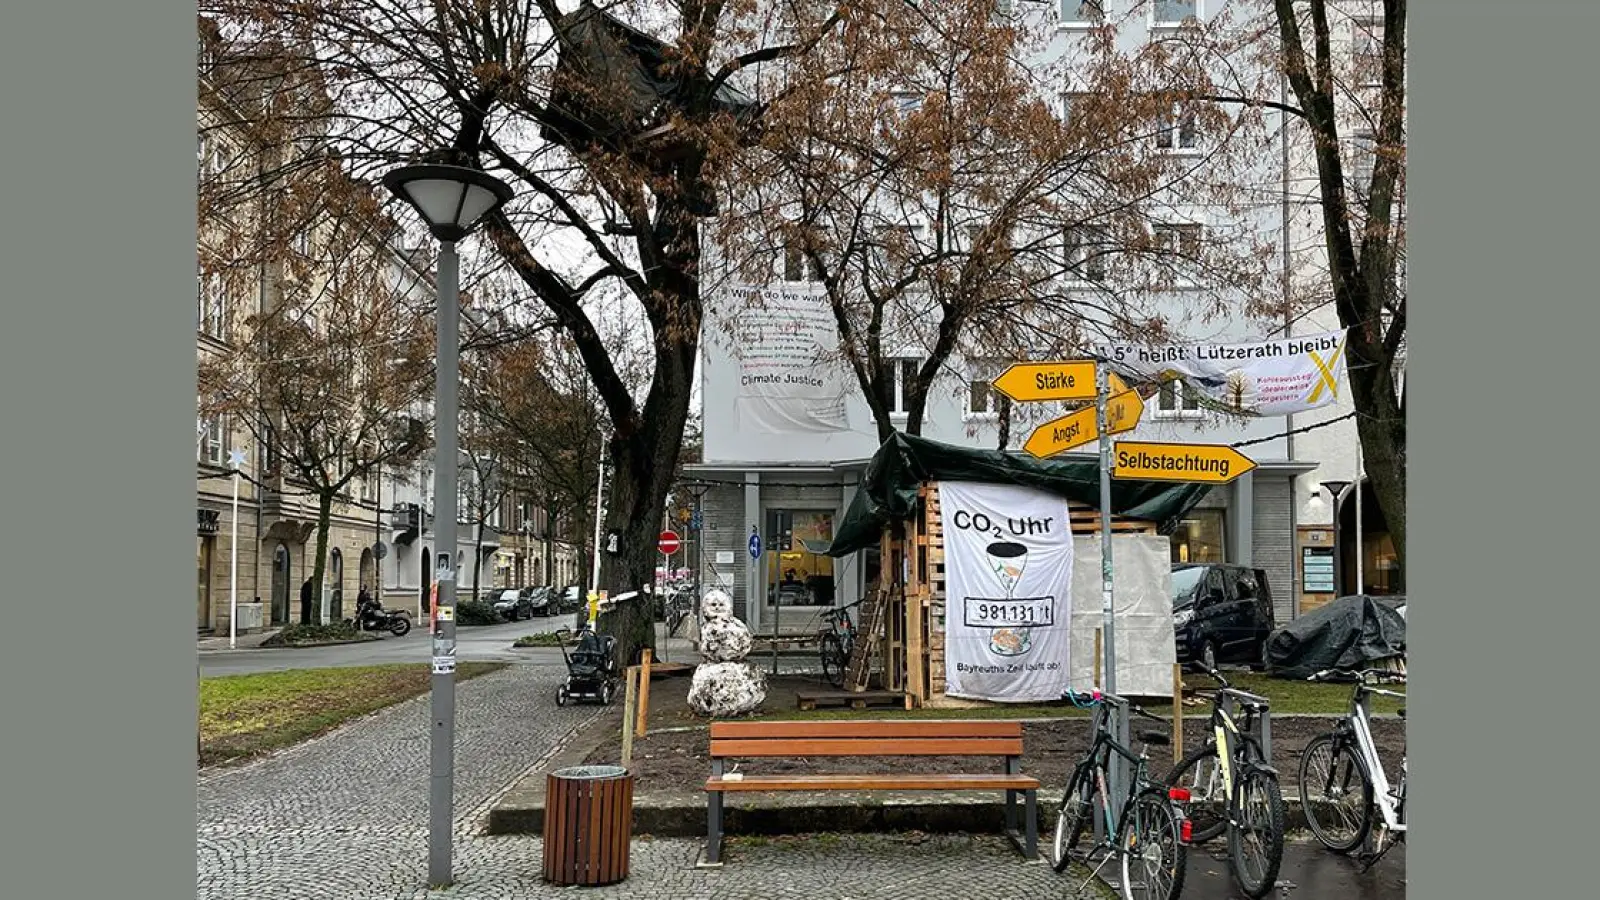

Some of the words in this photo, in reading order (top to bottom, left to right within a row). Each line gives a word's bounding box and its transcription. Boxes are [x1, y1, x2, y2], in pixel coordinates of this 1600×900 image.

[731, 288, 760, 299] Wh
[764, 290, 779, 299] do
[782, 292, 799, 301] we
[1139, 346, 1190, 363] heißt:
[1197, 342, 1282, 360] Lützerath
[1288, 336, 1338, 355] bleibt
[741, 373, 780, 386] Climate
[784, 374, 823, 388] Justice
[1036, 372, 1075, 390] Stärke
[1053, 421, 1080, 444] Angst
[1118, 451, 1229, 476] Selbstachtung
[1008, 516, 1054, 535] Uhr
[957, 662, 1004, 674] Bayreuths
